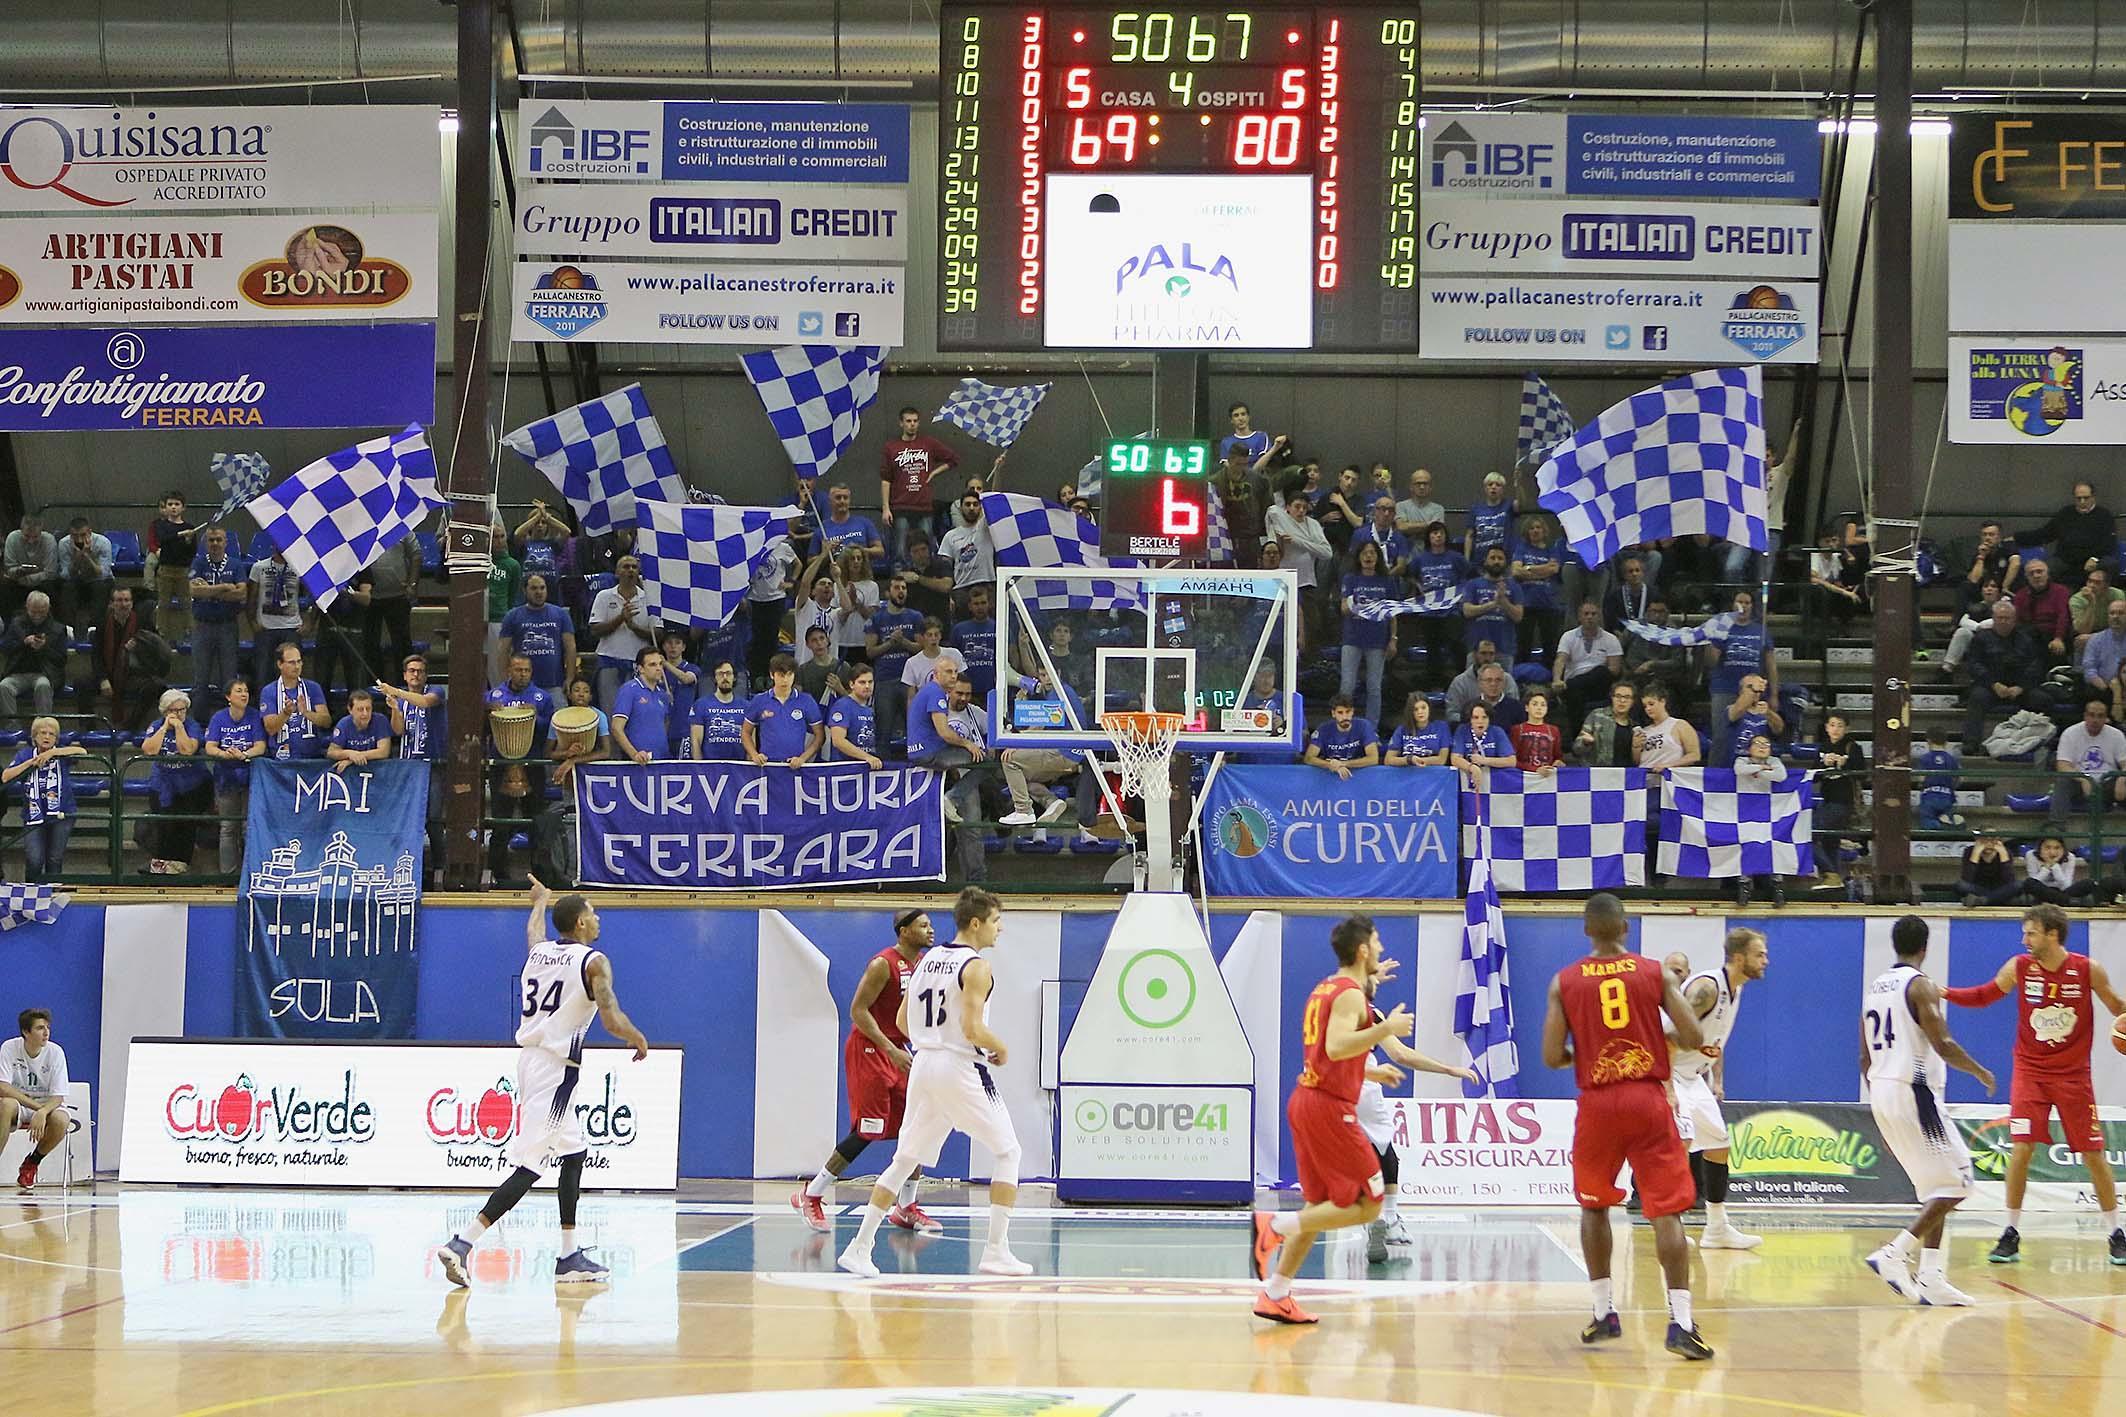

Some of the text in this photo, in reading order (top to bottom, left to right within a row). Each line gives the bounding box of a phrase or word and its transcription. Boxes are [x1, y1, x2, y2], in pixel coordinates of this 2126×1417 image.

[963, 17, 1041, 43] 0 3
[1112, 13, 1251, 63] 50 67
[1330, 19, 1415, 45] 1 00
[963, 44, 1041, 70] 8 0
[1320, 46, 1415, 71] 3 4
[956, 72, 1040, 97] 10 0
[1067, 68, 1091, 109] 5
[1169, 71, 1193, 107] 4
[1281, 69, 1306, 110] 5
[1320, 72, 1415, 99] 3 7
[954, 98, 1040, 124] 11 0
[1100, 91, 1156, 107] CASA
[1197, 91, 1265, 107] OSPITI
[679, 118, 869, 132] Costruzione, manutenzione
[1320, 100, 1415, 125] 4 8
[582, 130, 650, 161] IBF
[678, 136, 878, 150] e ristrutturazione di immobili
[954, 126, 1040, 152] 13 2
[1071, 115, 1136, 165] 69
[1235, 116, 1300, 166] 80
[1320, 126, 1415, 153] 2 11
[1582, 131, 1776, 148] Costruzione, manutenzione
[0, 112, 268, 207] Quisisana
[546, 161, 631, 174] costruzioni
[678, 153, 887, 168] civili, industriali e commerciali
[945, 153, 1039, 178] 21 5
[1329, 155, 1415, 179] 1 14
[1483, 144, 1553, 175] IBF
[1582, 150, 1785, 166] e ristrutturazione di immobili
[115, 167, 267, 183] OSPEDALE PRIVATO
[1448, 175, 1535, 189] costruzioni
[1582, 167, 1795, 184] civili, industriali e commerciali
[153, 184, 267, 200] ACCREDITATO
[945, 179, 1039, 206] 24 2
[1320, 181, 1415, 207] 5 15
[523, 205, 897, 242] Gruppo ITALIAN CREDIT
[945, 207, 1039, 233] 29 3
[1320, 209, 1415, 234] 4 17
[41, 233, 224, 260] ARTIGIANI
[945, 234, 1038, 260] 09 0
[1320, 235, 1413, 261] 0 19
[1426, 221, 1812, 259] Gruppo ITALIAN CREDIT
[71, 263, 195, 291] PASTAI
[945, 261, 1038, 288] 34 2
[1116, 242, 1239, 296] PALA
[1319, 263, 1414, 289] 0 43
[261, 269, 388, 296] BONDI
[627, 273, 895, 295] www.pallacanestroferrara.it
[25, 296, 239, 313] www.artigianipastaibondi.com
[533, 291, 601, 301] PALLACANESTRO
[944, 288, 1038, 314] 39 2
[1431, 287, 1703, 308] www.pallacanestroferrara.it
[532, 304, 601, 319] FERRARA
[659, 314, 779, 330] FOLLOW US ON
[1728, 312, 1799, 321] PALLACANESTRO
[556, 322, 576, 331] 2011
[1464, 328, 1586, 345] FOLLOW US ON
[1728, 326, 1798, 341] FERRARA
[1753, 343, 1774, 352] 2011
[1972, 354, 2047, 365] Dalla TERRA
[1972, 367, 2040, 379] alla LUNA
[0, 366, 266, 419] Confartigianato
[142, 408, 264, 426] FERRARA
[1111, 445, 1205, 473] 50 63
[1163, 479, 1199, 535] 6
[295, 772, 373, 813] MAI
[585, 767, 933, 815] CURVA NORD
[1282, 800, 1445, 817] AMICI DELLA
[1262, 808, 1279, 848] ESTENSI
[603, 825, 921, 877] FERRARA
[1282, 821, 1448, 863] CURVA
[1581, 958, 1637, 977] MARKS
[269, 978, 380, 1023] SOLA
[522, 978, 564, 1017] 34
[1599, 978, 1630, 1030] 8
[1866, 1007, 1895, 1050] 24
[1113, 1103, 1227, 1132] core41
[1418, 1102, 1542, 1145] ITAS
[1077, 1136, 1229, 1145] WEB SOLUTIONS
[186, 1147, 349, 1167] buono, fresco, naturale.
[447, 1149, 493, 1170] buono,
[1401, 1183, 1501, 1196] Cavour, 150
[1755, 1181, 1849, 1193] Uova Italiane.
